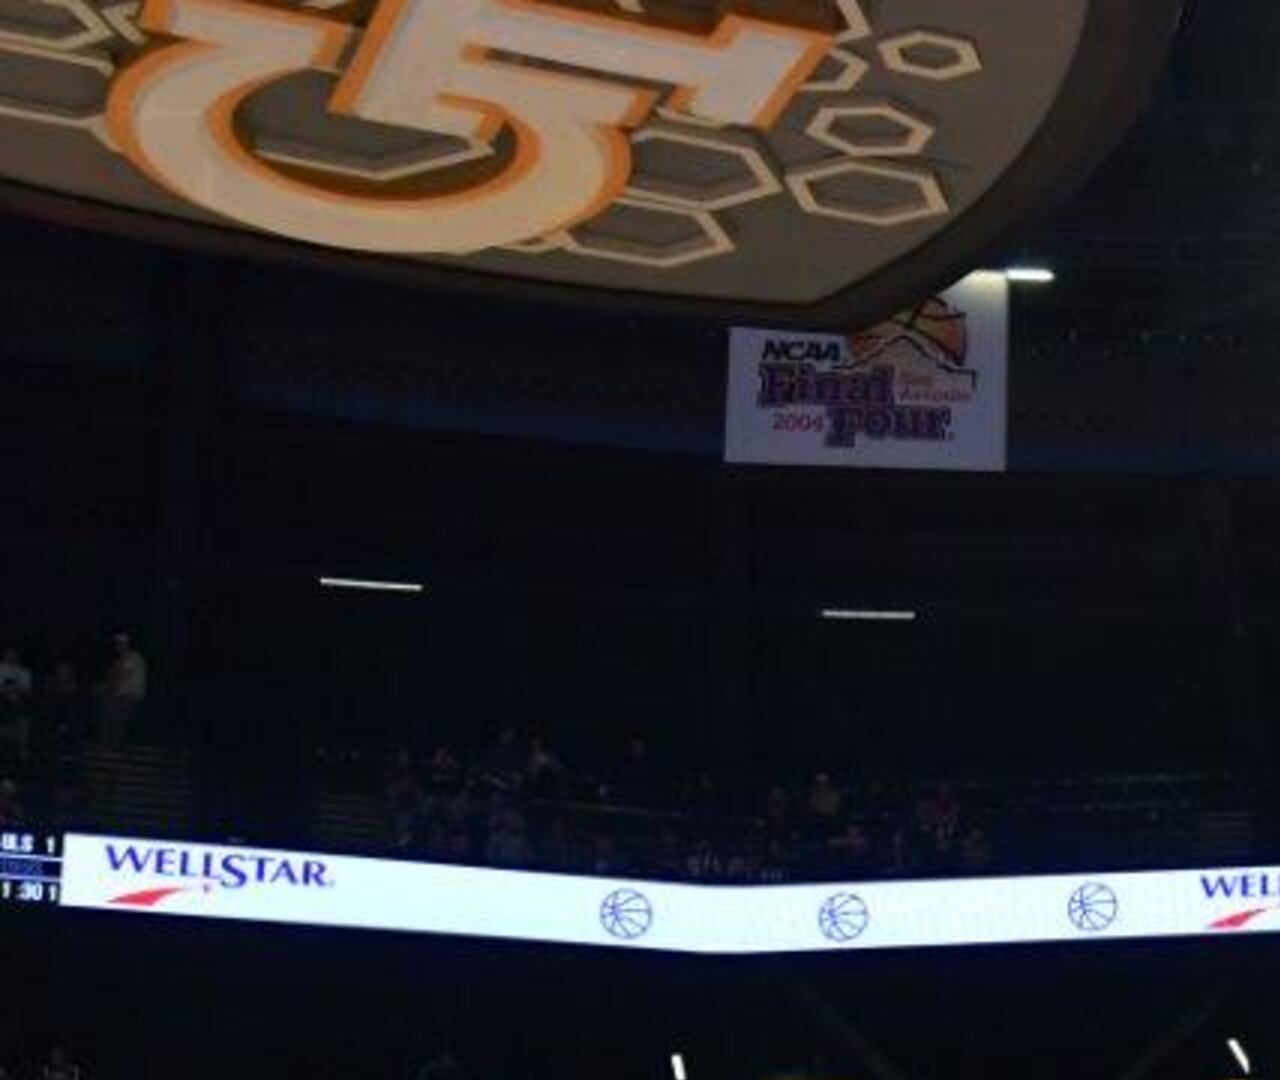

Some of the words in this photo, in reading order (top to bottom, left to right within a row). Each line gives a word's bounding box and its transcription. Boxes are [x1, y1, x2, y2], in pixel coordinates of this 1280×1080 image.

[762, 338, 840, 362] NCAA
[757, 362, 895, 407] Final
[105, 843, 327, 889] WELLSTAR
